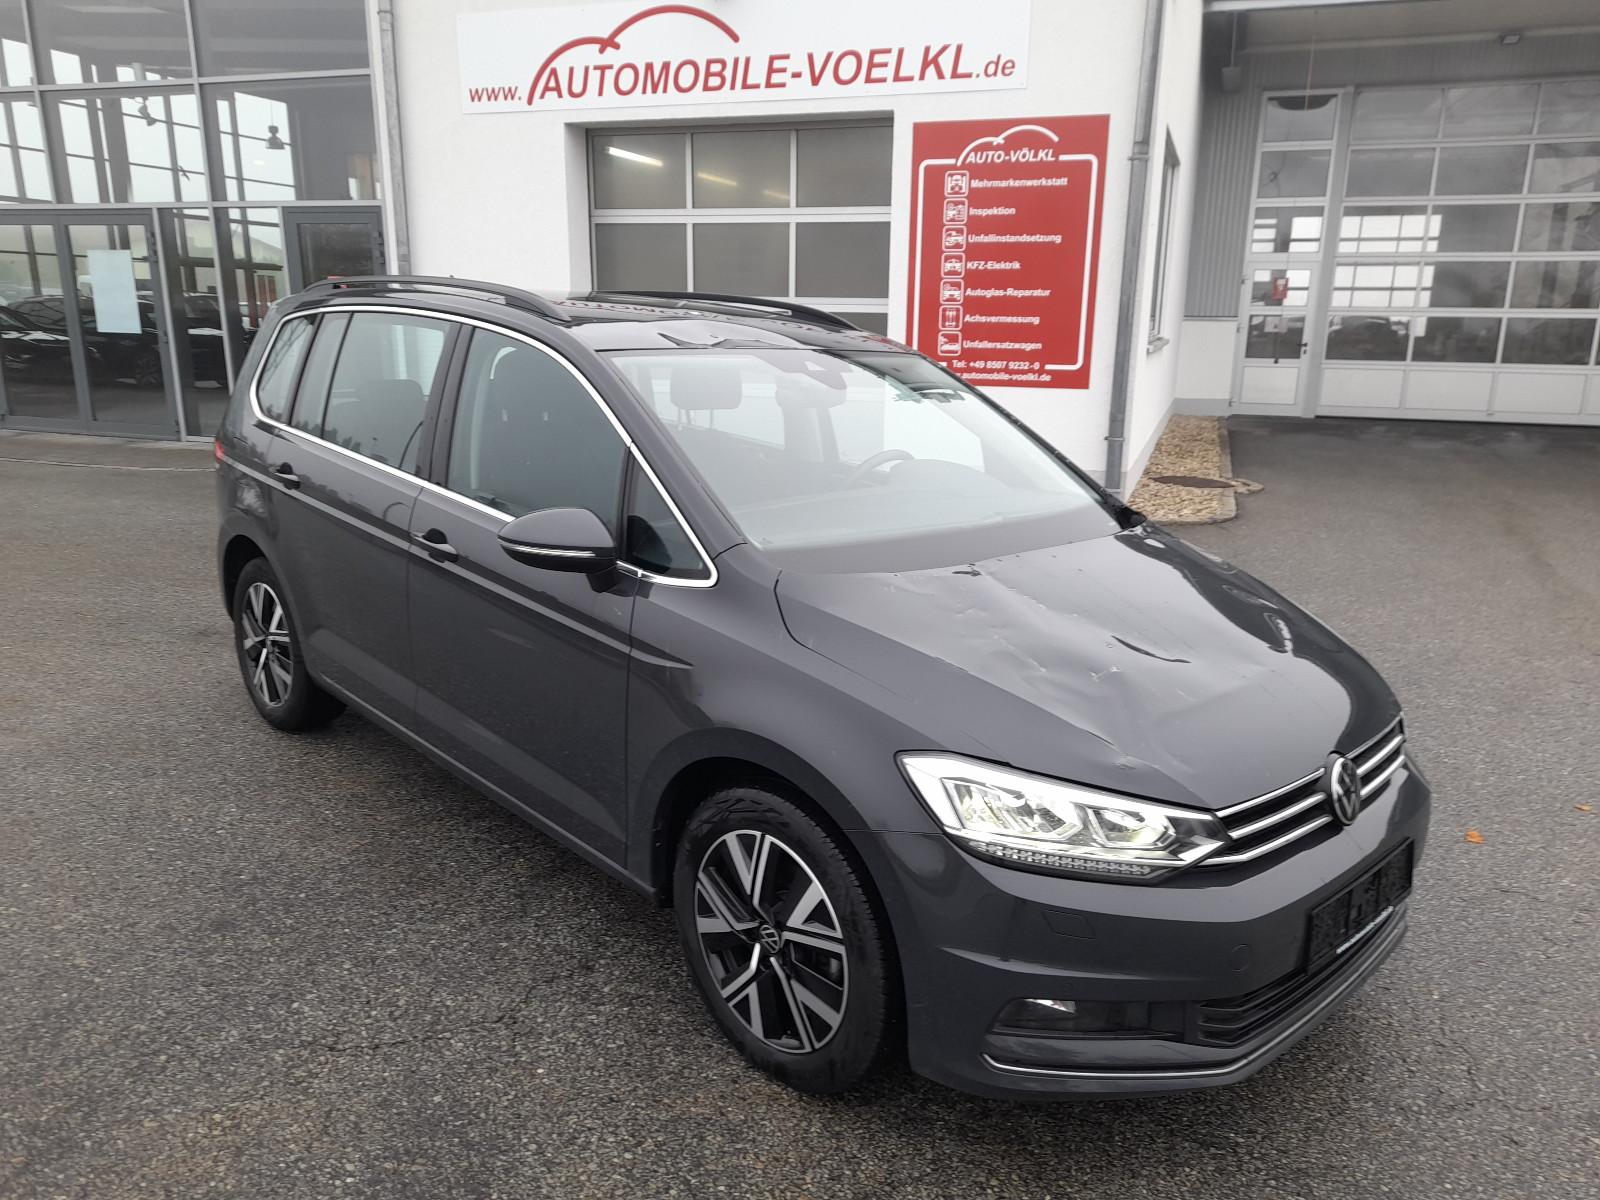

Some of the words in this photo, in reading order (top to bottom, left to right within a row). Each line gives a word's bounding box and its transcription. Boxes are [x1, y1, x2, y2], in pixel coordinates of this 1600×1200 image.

[966, 148, 1056, 164] AUTO-VÖLKL
[971, 177, 1068, 189] Mehrmarkenwerkstatt
[969, 206, 1016, 217] Inspektion
[968, 233, 1062, 244] Unfallinstandsetzung
[966, 260, 1021, 271] KFZ-Elektrik
[965, 287, 1051, 298] Autoglas-Reparatur
[964, 314, 1040, 325] Achsvermessung
[963, 340, 1042, 351] Unfallersatzwagen
[969, 361, 985, 369] +49
